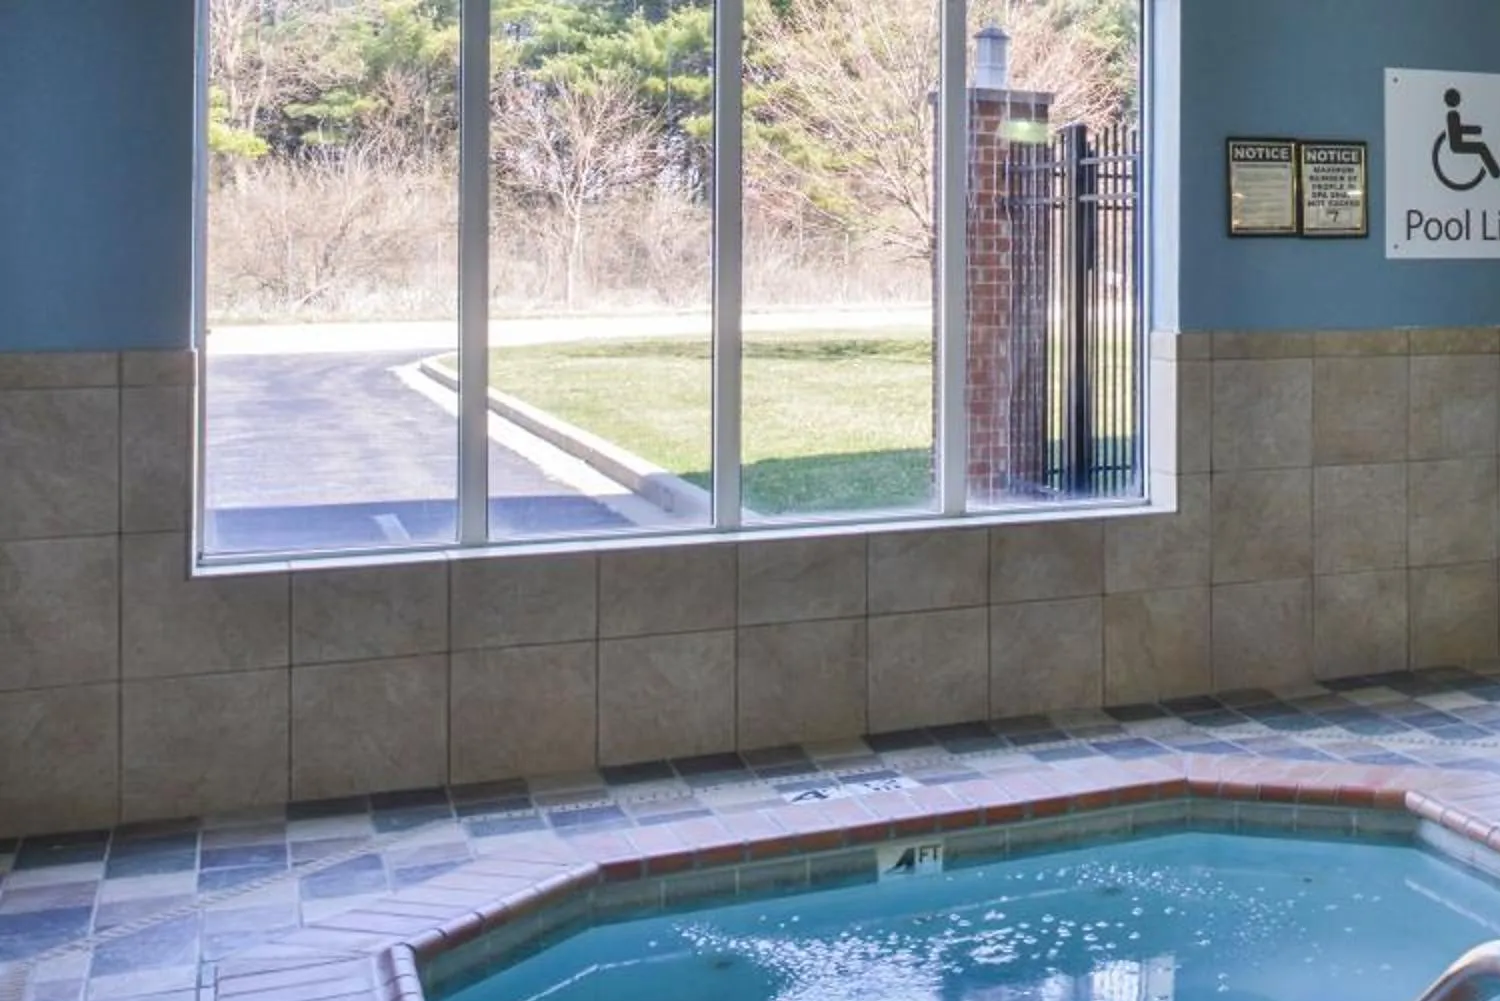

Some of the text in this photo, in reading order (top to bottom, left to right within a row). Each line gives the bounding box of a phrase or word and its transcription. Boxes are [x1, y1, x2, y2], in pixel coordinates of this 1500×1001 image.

[1233, 147, 1290, 160] NOTICE
[1306, 149, 1359, 162] NOTICE
[1406, 208, 1470, 241] Pool
[918, 844, 942, 864] FT
